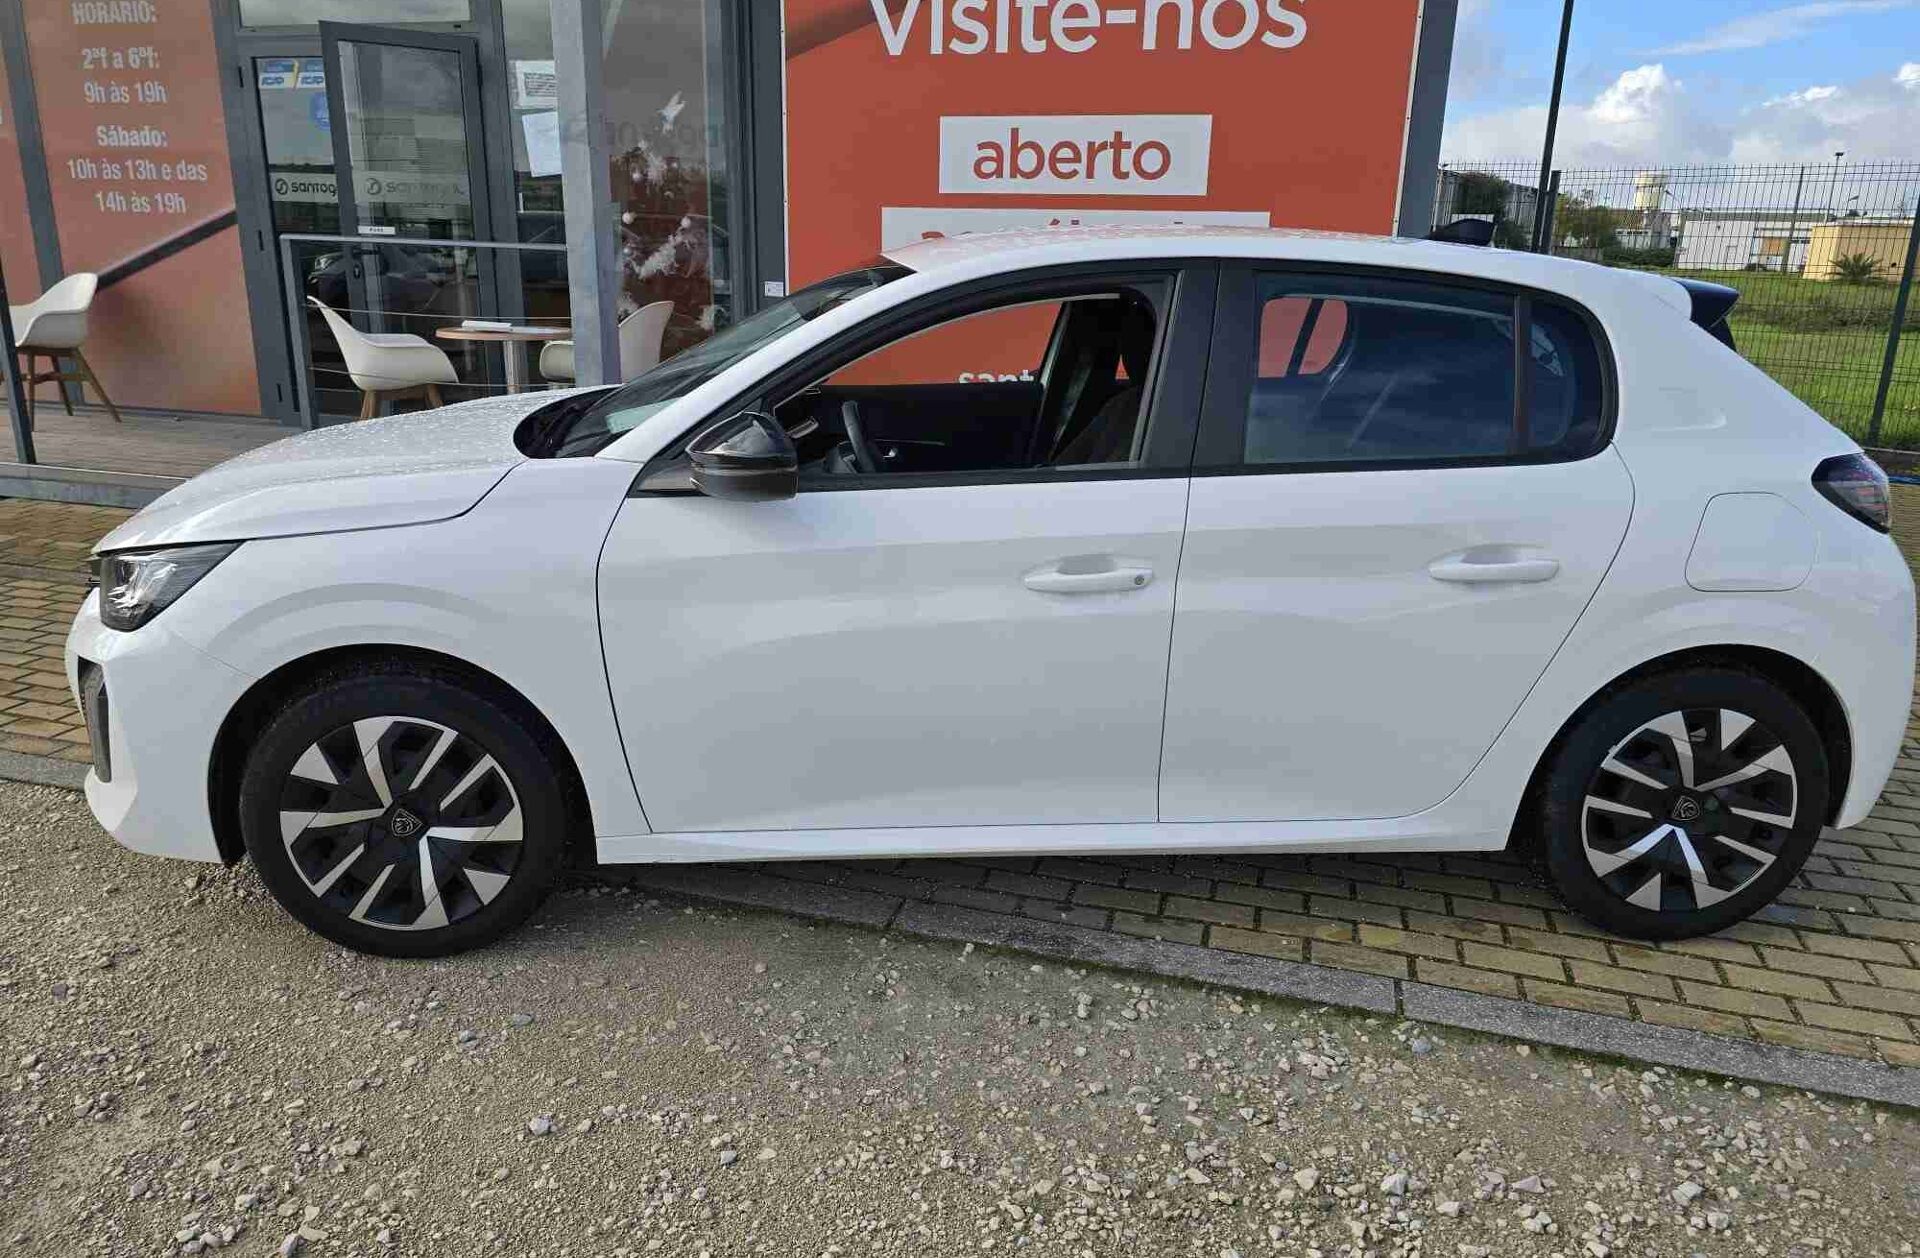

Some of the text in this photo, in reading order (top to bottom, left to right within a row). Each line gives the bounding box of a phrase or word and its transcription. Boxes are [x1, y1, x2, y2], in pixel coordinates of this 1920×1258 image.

[113, 52, 124, 69] a
[84, 81, 168, 103] 9h às 19h
[97, 124, 168, 147] Sábado:
[972, 127, 1172, 180] aberto
[67, 157, 208, 181] 10h às 13h e das
[96, 190, 187, 213] 14h às 19h
